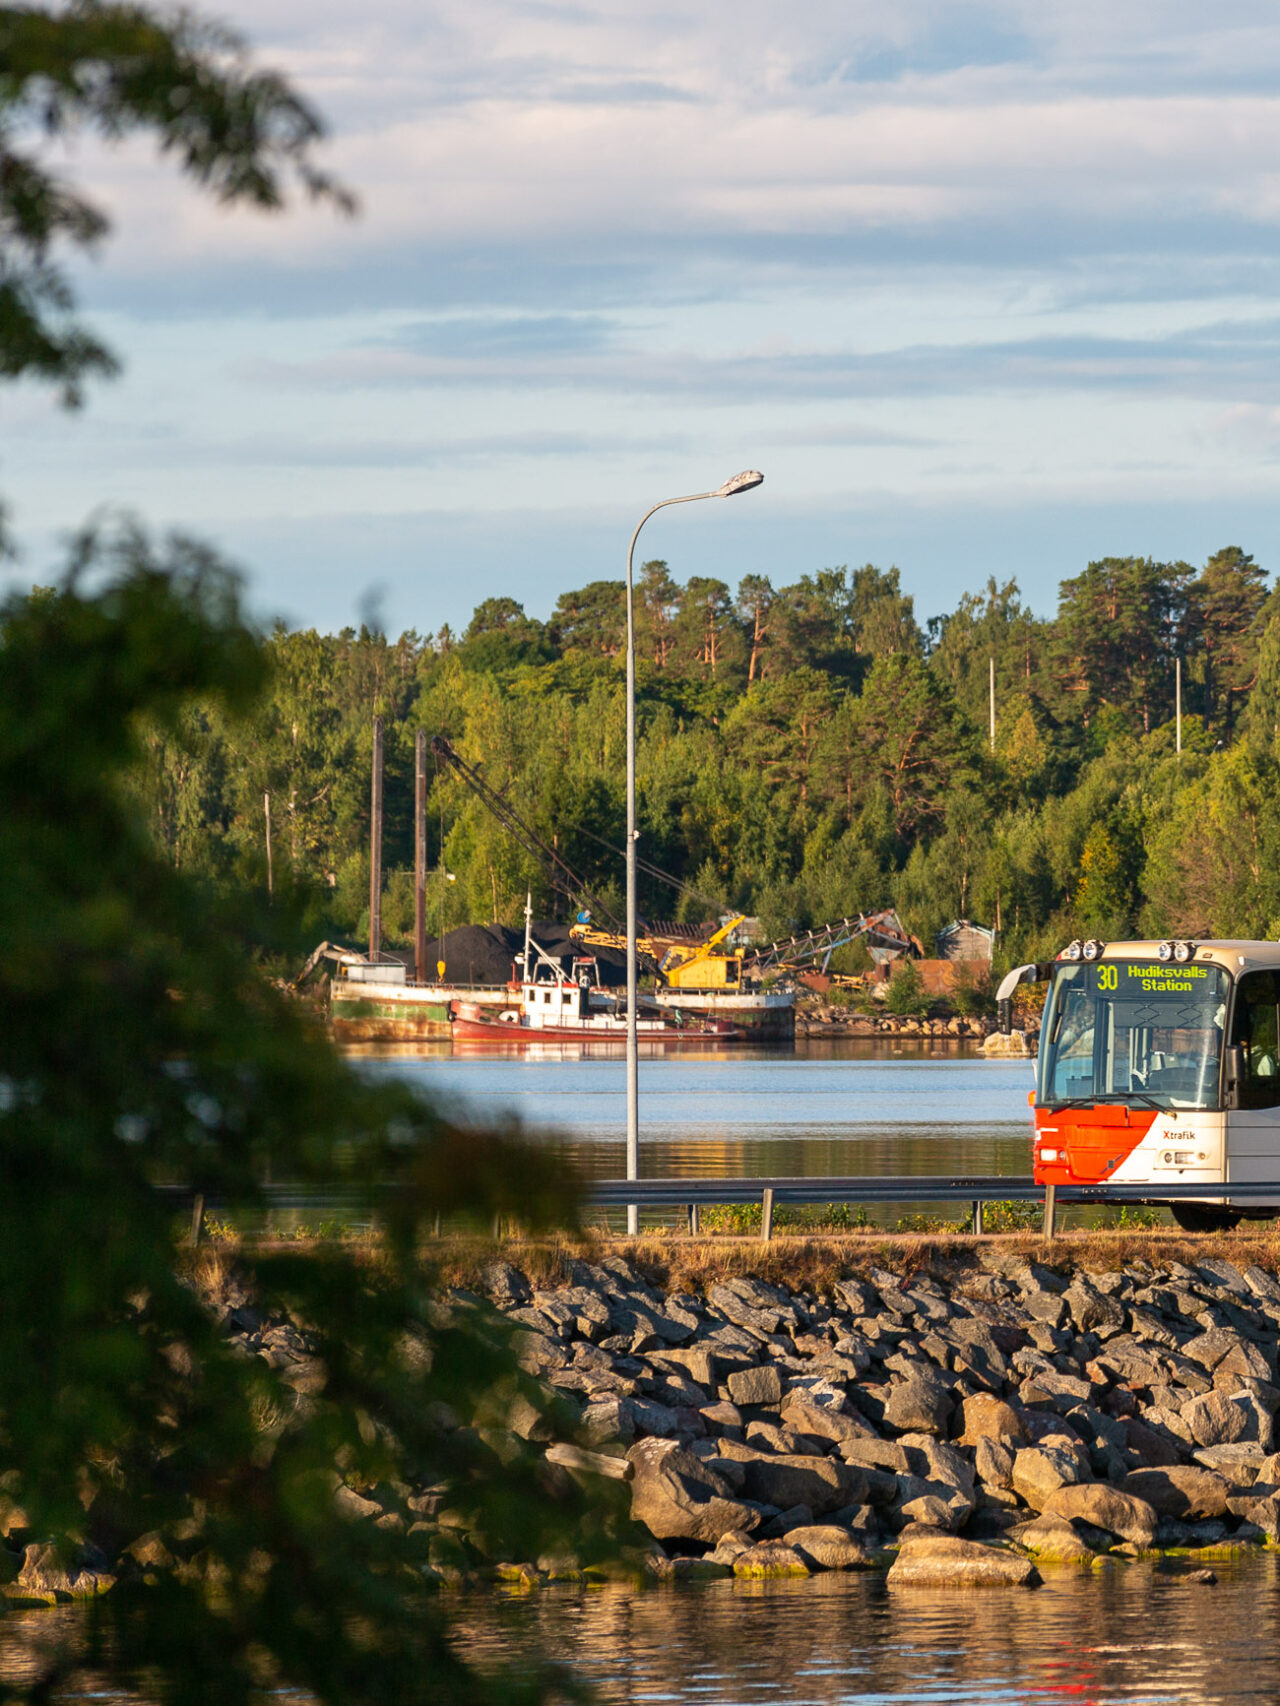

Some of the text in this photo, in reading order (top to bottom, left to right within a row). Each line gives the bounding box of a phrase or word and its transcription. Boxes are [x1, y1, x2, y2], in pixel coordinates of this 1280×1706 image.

[1097, 964, 1118, 990] 30
[1127, 965, 1208, 978] Hudiksvalls
[1141, 979, 1192, 991] Station
[1163, 1130, 1196, 1140] Xtrafik
